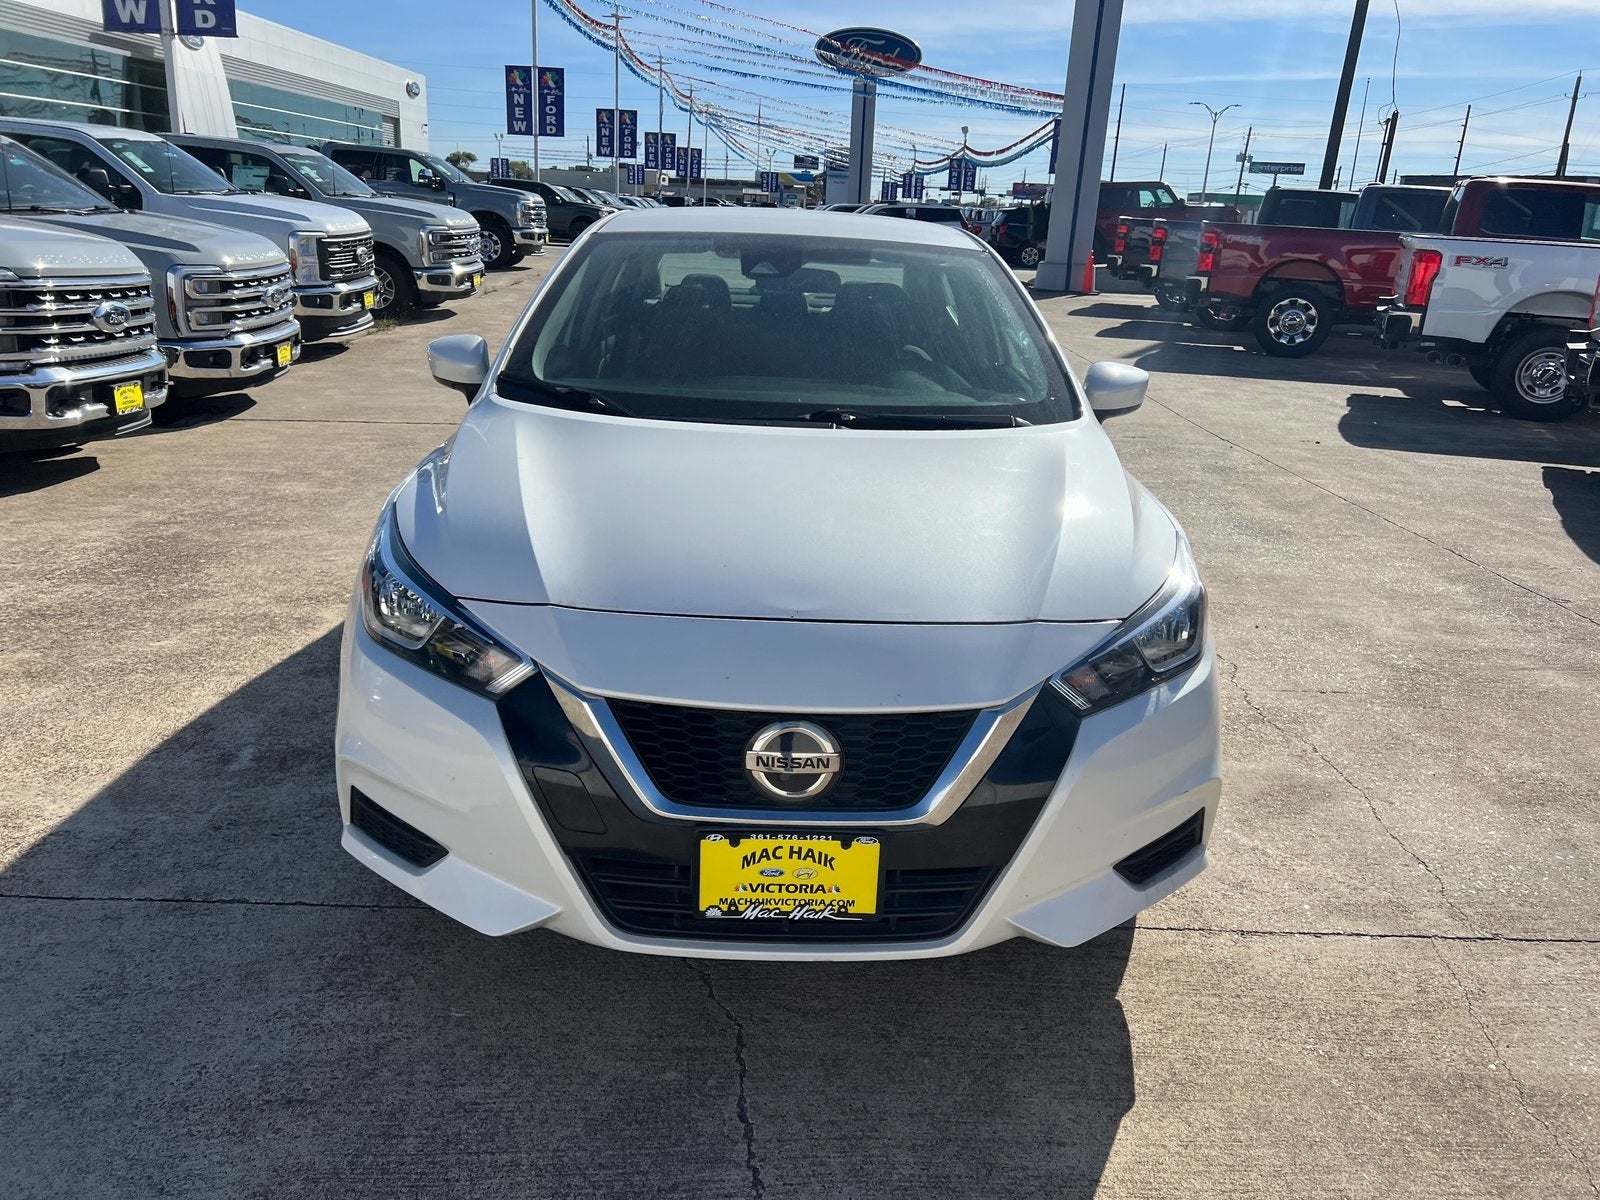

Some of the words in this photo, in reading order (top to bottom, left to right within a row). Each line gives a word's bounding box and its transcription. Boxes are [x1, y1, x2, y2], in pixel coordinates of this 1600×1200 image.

[513, 94, 526, 131] NEW
[545, 96, 557, 134] FORD
[600, 128, 611, 155] NEW
[623, 129, 632, 156] FORD
[648, 147, 656, 167] NEW
[1454, 256, 1509, 266] FX4
[755, 755, 830, 769] NISSAN
[750, 833, 833, 841] 361-576-1221
[741, 845, 784, 870] MAC
[788, 845, 836, 871] HAIK
[762, 869, 782, 877] Ford
[749, 883, 827, 894] VICTORIA
[718, 897, 856, 908] MACHAIKVICTORIA.COM
[741, 904, 787, 920] Mac
[788, 905, 837, 920] Haik
